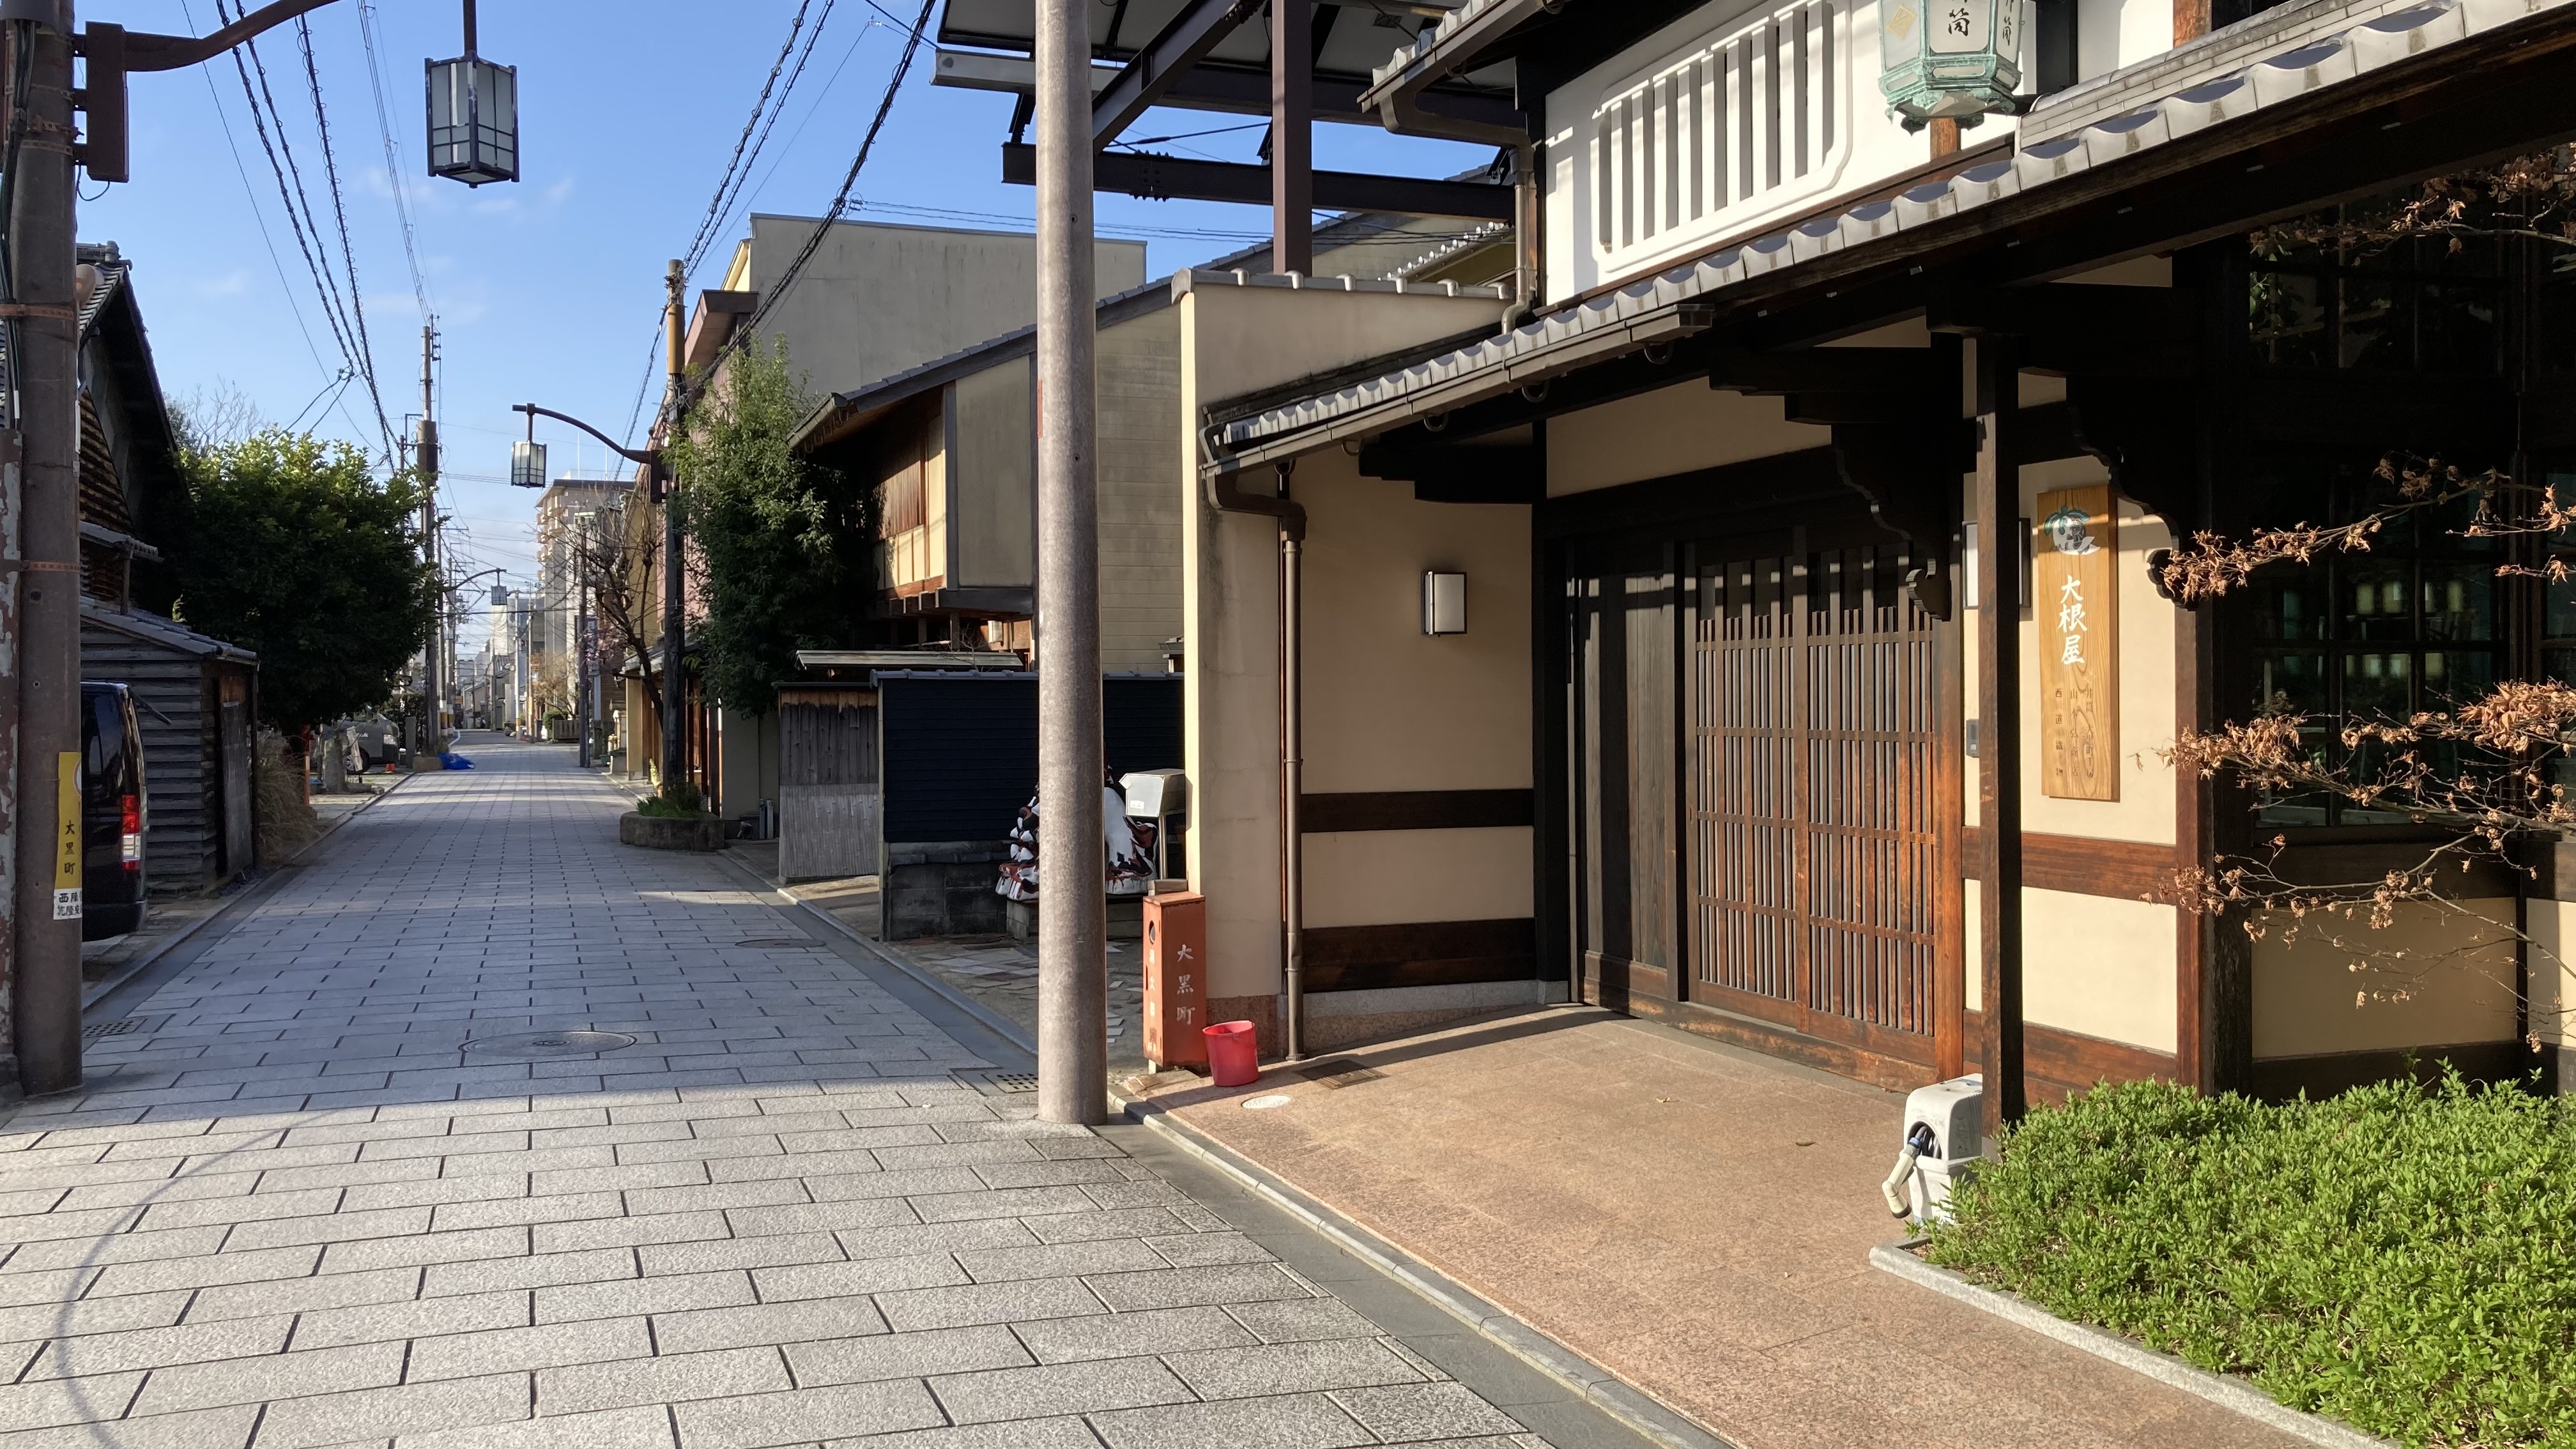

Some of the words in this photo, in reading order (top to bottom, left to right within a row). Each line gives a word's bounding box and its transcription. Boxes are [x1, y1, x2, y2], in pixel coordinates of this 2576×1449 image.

[1947, 0, 1970, 36] 筒
[2057, 574, 2088, 664] 大根屋
[64, 820, 76, 875] 大黒町
[59, 891, 82, 903] 西陣
[1177, 944, 1195, 1025] 大黒町
